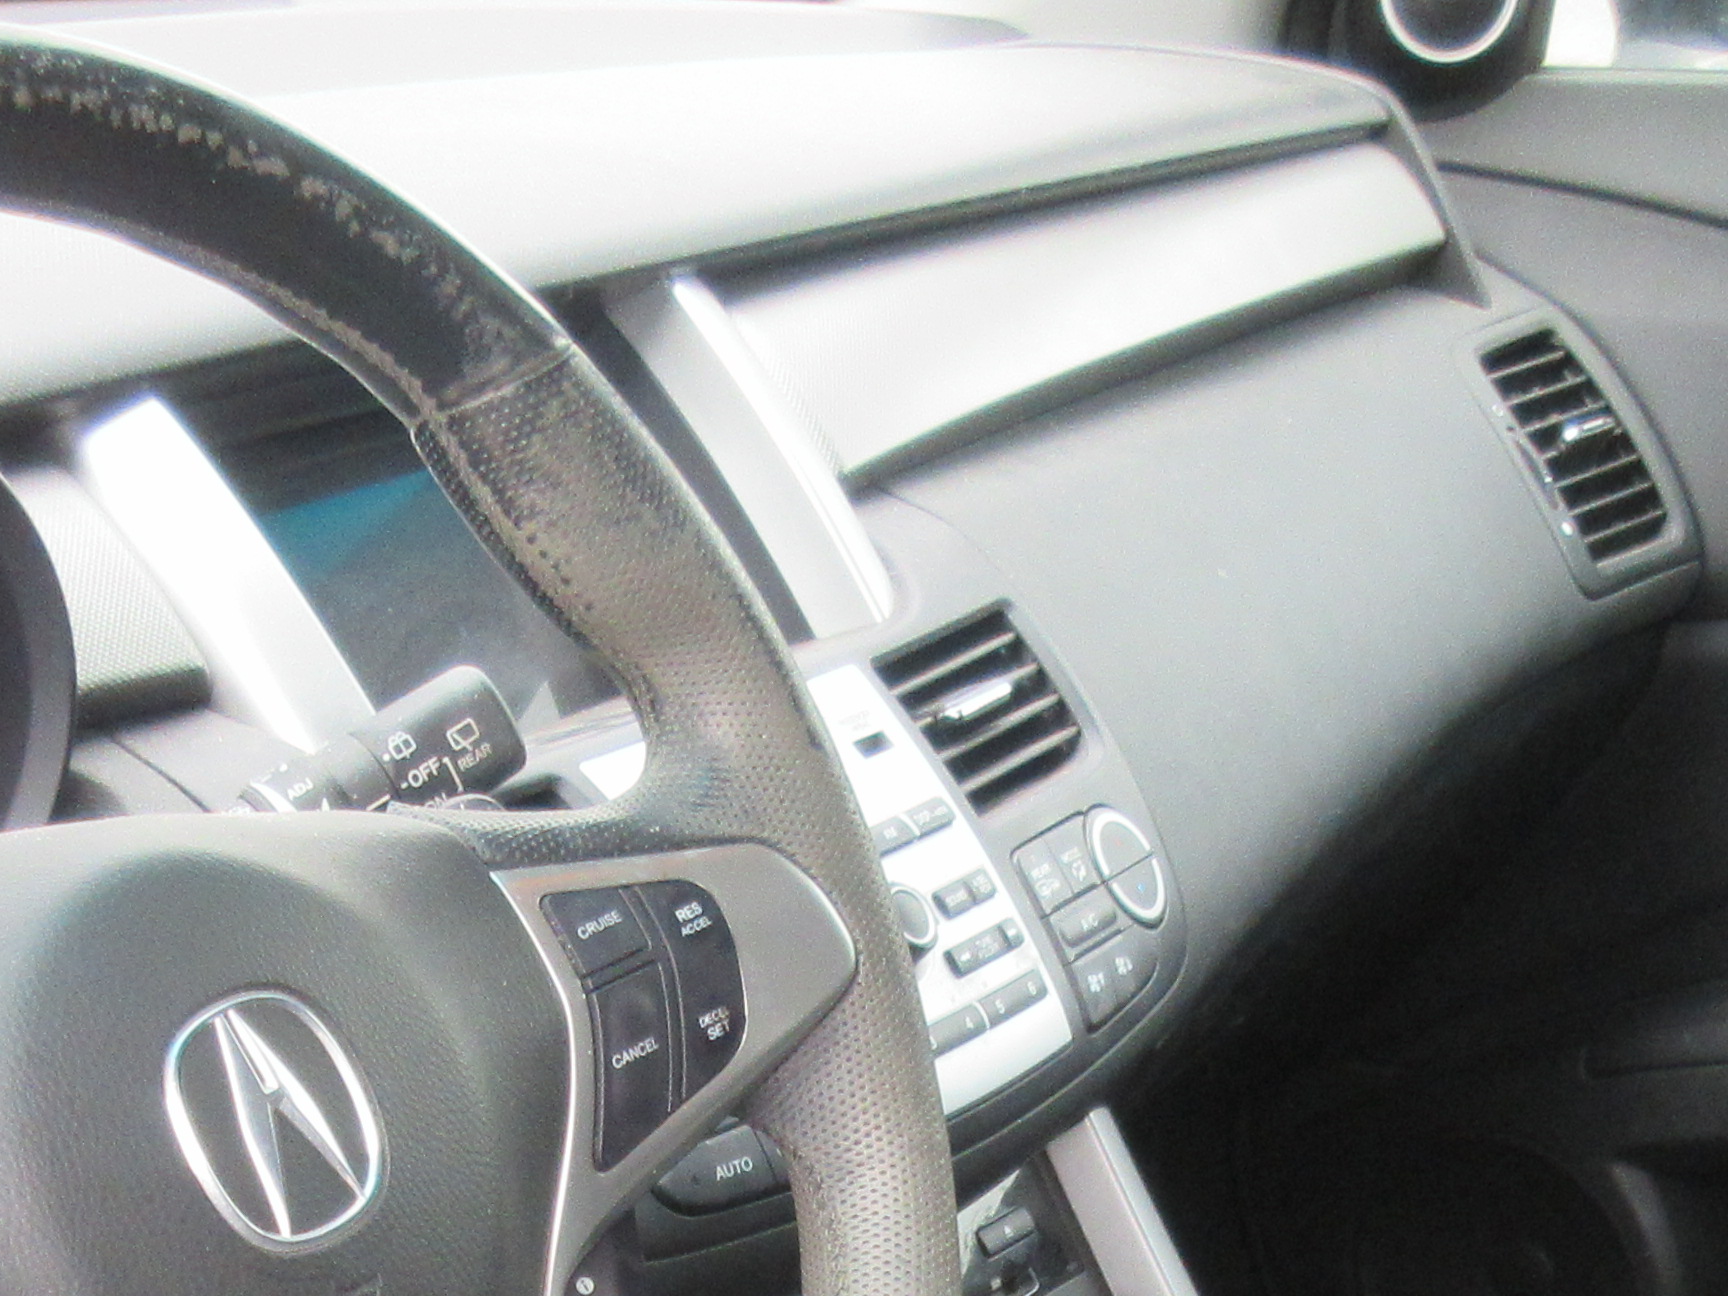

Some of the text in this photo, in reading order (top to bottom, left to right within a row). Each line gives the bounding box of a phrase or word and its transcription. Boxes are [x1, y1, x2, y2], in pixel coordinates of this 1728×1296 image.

[408, 756, 441, 789] OFF
[286, 777, 314, 801] ADJ
[674, 901, 703, 923] RES
[577, 909, 623, 940] CRUISE
[681, 915, 713, 937] ACCEL
[707, 1021, 729, 1041] SET
[612, 1036, 660, 1069] CANCEL
[715, 1156, 753, 1181] AUTO
